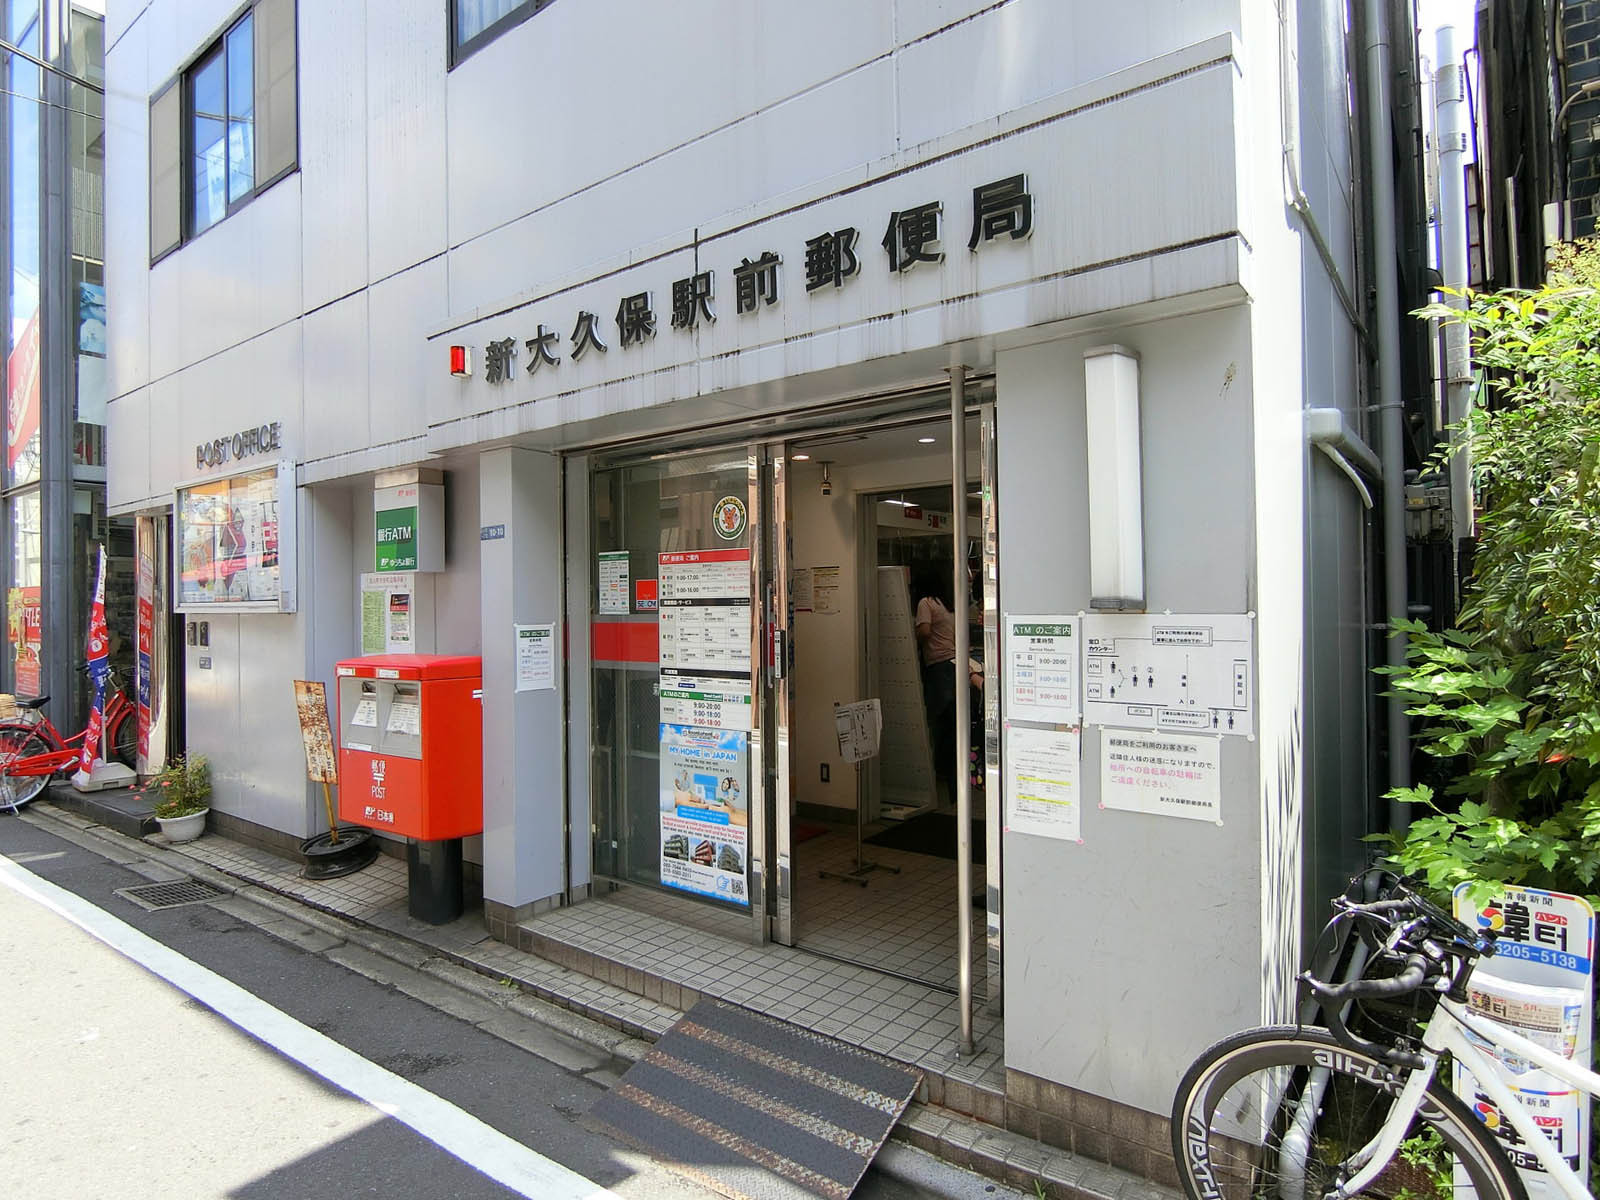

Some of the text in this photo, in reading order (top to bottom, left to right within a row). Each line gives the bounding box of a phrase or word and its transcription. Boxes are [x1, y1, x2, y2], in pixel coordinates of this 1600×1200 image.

[484, 172, 1035, 386] 新大久保駅前郵便局
[196, 421, 281, 469] POST OFFICE
[377, 526, 412, 542] 銀行ATM
[1013, 626, 1071, 635] ATM のご案内
[1109, 738, 1197, 752] 郵便局をご利用のお客さまへ
[680, 748, 701, 757] HOME
[712, 752, 737, 761] JAPAN
[371, 786, 386, 799] POST
[1536, 913, 1567, 925] ハント
